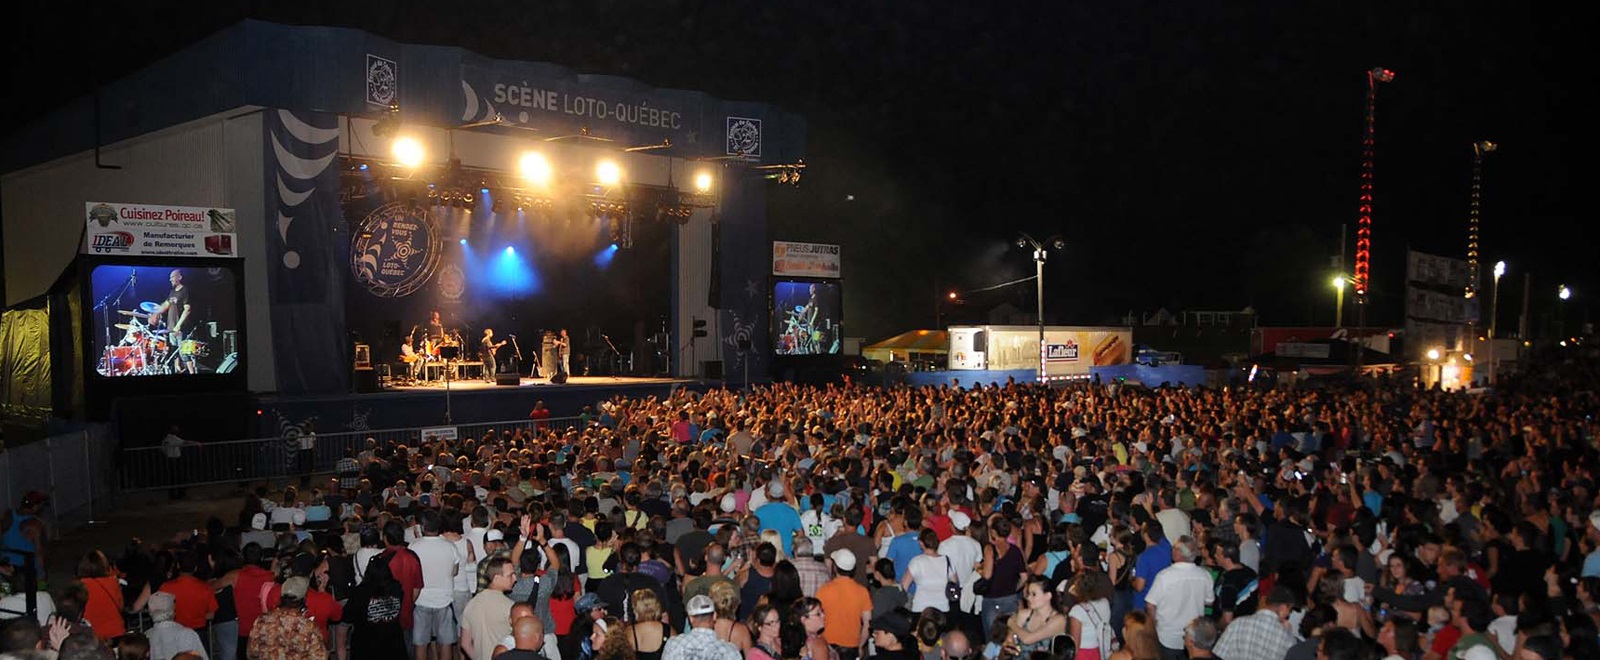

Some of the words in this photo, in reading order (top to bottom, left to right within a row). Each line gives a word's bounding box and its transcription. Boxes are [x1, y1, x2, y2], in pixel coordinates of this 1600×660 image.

[494, 80, 560, 111] SCÈNE
[564, 93, 682, 130] LOTO-QUÉBEC
[120, 207, 163, 221] Cuisinez
[165, 209, 205, 223] Poireau!
[143, 231, 195, 240] Manufacturier
[154, 240, 196, 250] Remorques
[1048, 345, 1077, 358] Lafleur
